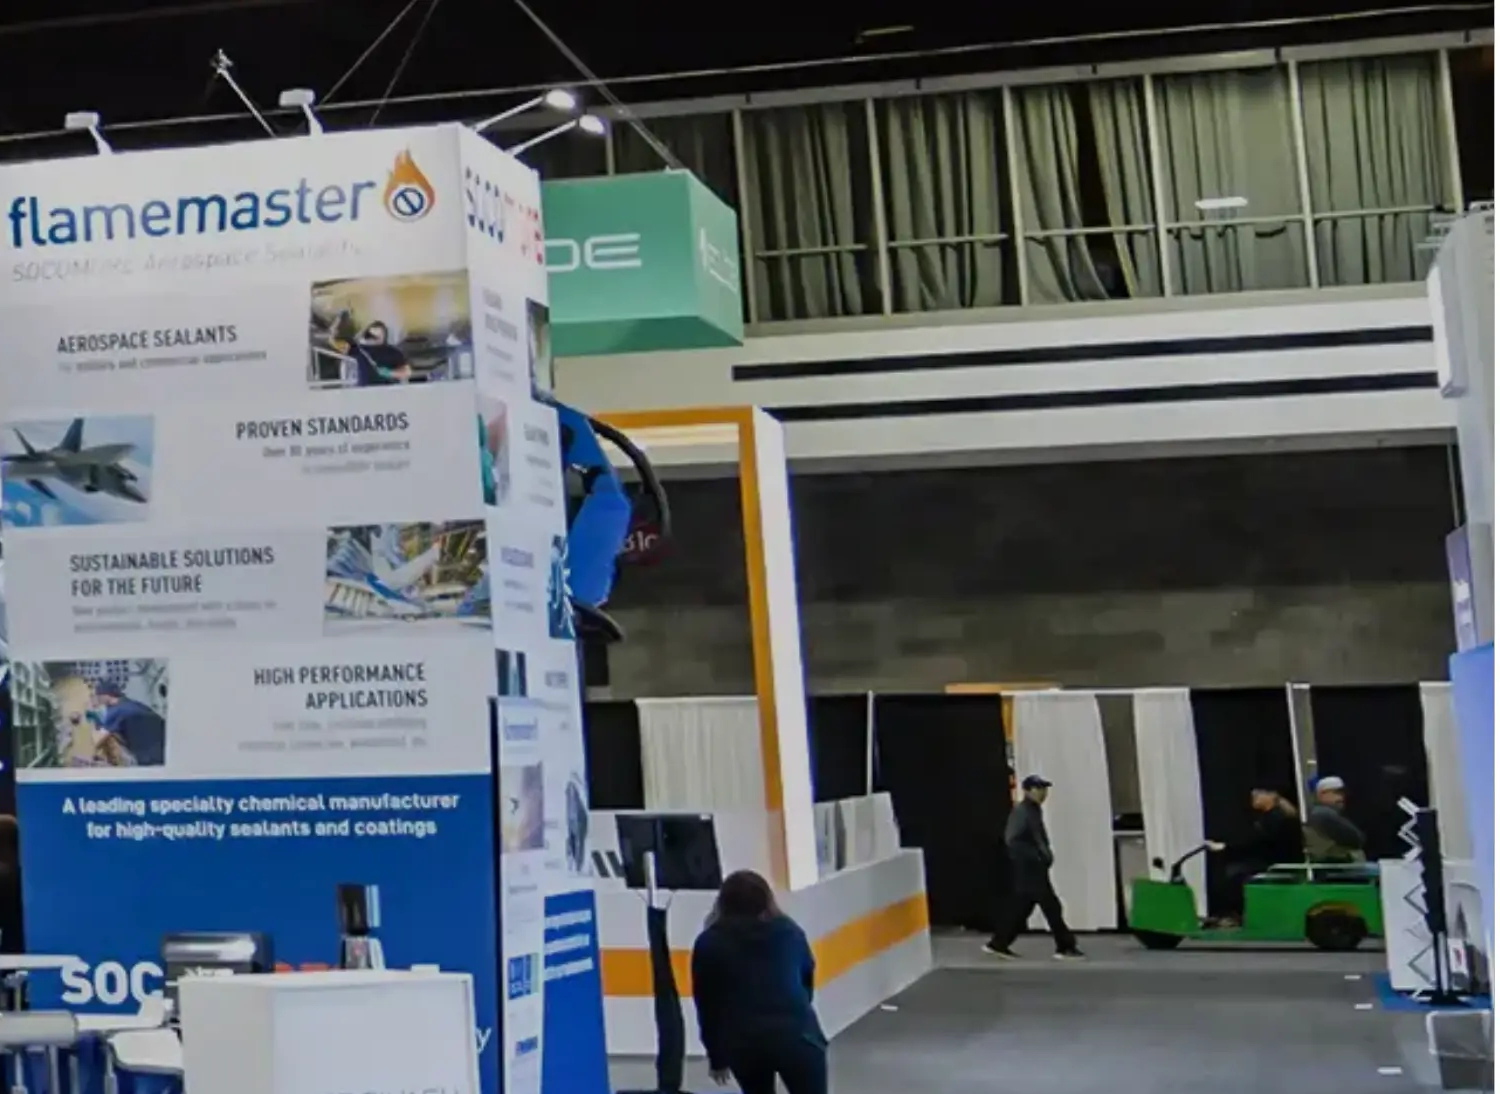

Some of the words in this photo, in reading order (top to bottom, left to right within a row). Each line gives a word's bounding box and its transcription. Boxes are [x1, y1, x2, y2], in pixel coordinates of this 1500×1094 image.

[8, 177, 376, 249] flamemaster
[57, 330, 149, 354] AEROSPACE
[153, 325, 239, 349] SEALANTS
[235, 419, 302, 440] PROVEN
[307, 411, 410, 436] STANDARDS
[69, 549, 179, 573] SUSTAINABLE
[183, 546, 276, 569] SOLUTIONS
[70, 578, 103, 598] FOR
[107, 576, 137, 596] THE
[141, 573, 203, 596] FUTURE
[253, 666, 295, 686] HIGH
[299, 662, 427, 685] PERFORMANCE
[305, 688, 429, 710] APPLICATIONS
[62, 798, 76, 815] A
[78, 796, 146, 818] leading
[149, 795, 235, 816] specialty
[237, 793, 326, 812] chemical
[328, 792, 461, 811] manufacturer
[86, 821, 111, 839] for
[115, 820, 226, 841] high-quality
[229, 819, 311, 838] sealants
[314, 818, 351, 837] and
[353, 818, 438, 838] coatings
